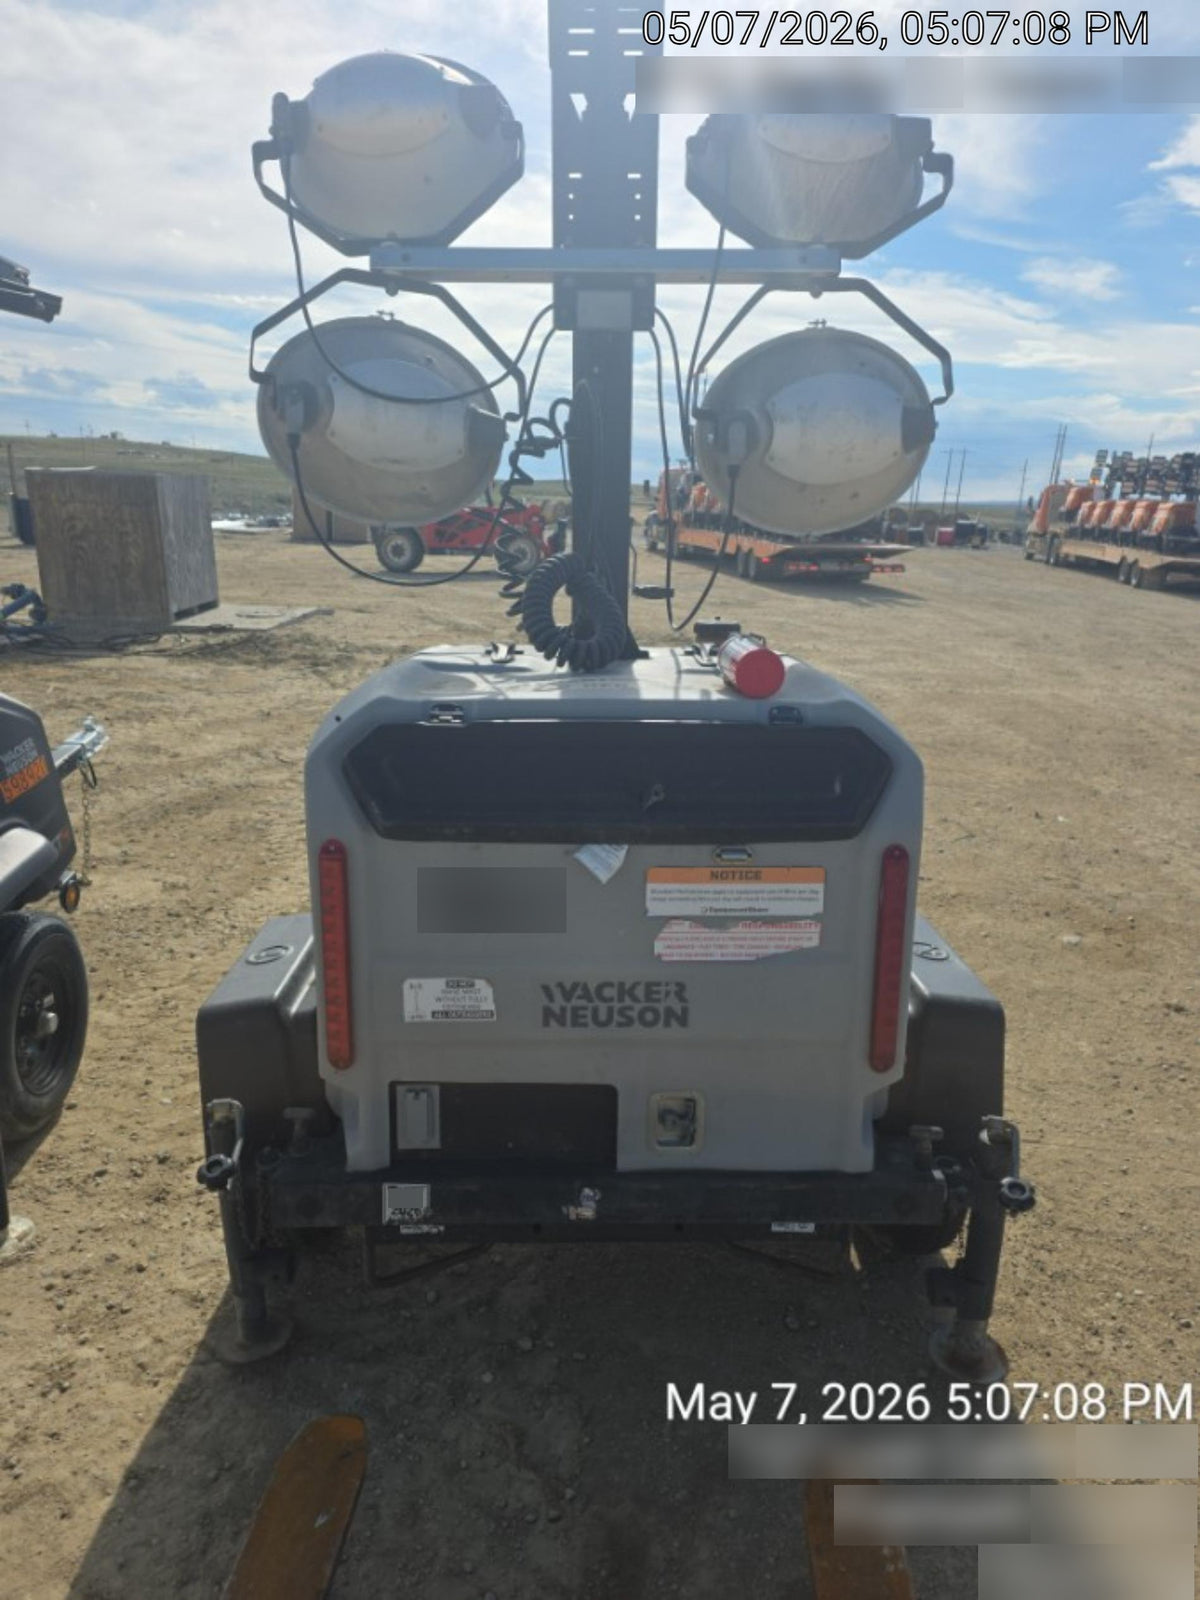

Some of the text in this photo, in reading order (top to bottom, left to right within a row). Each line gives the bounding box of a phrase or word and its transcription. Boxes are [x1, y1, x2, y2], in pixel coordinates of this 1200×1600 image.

[709, 870, 763, 881] NOTICE
[540, 980, 689, 1004] WACKER
[541, 1004, 689, 1028] NEUSON
